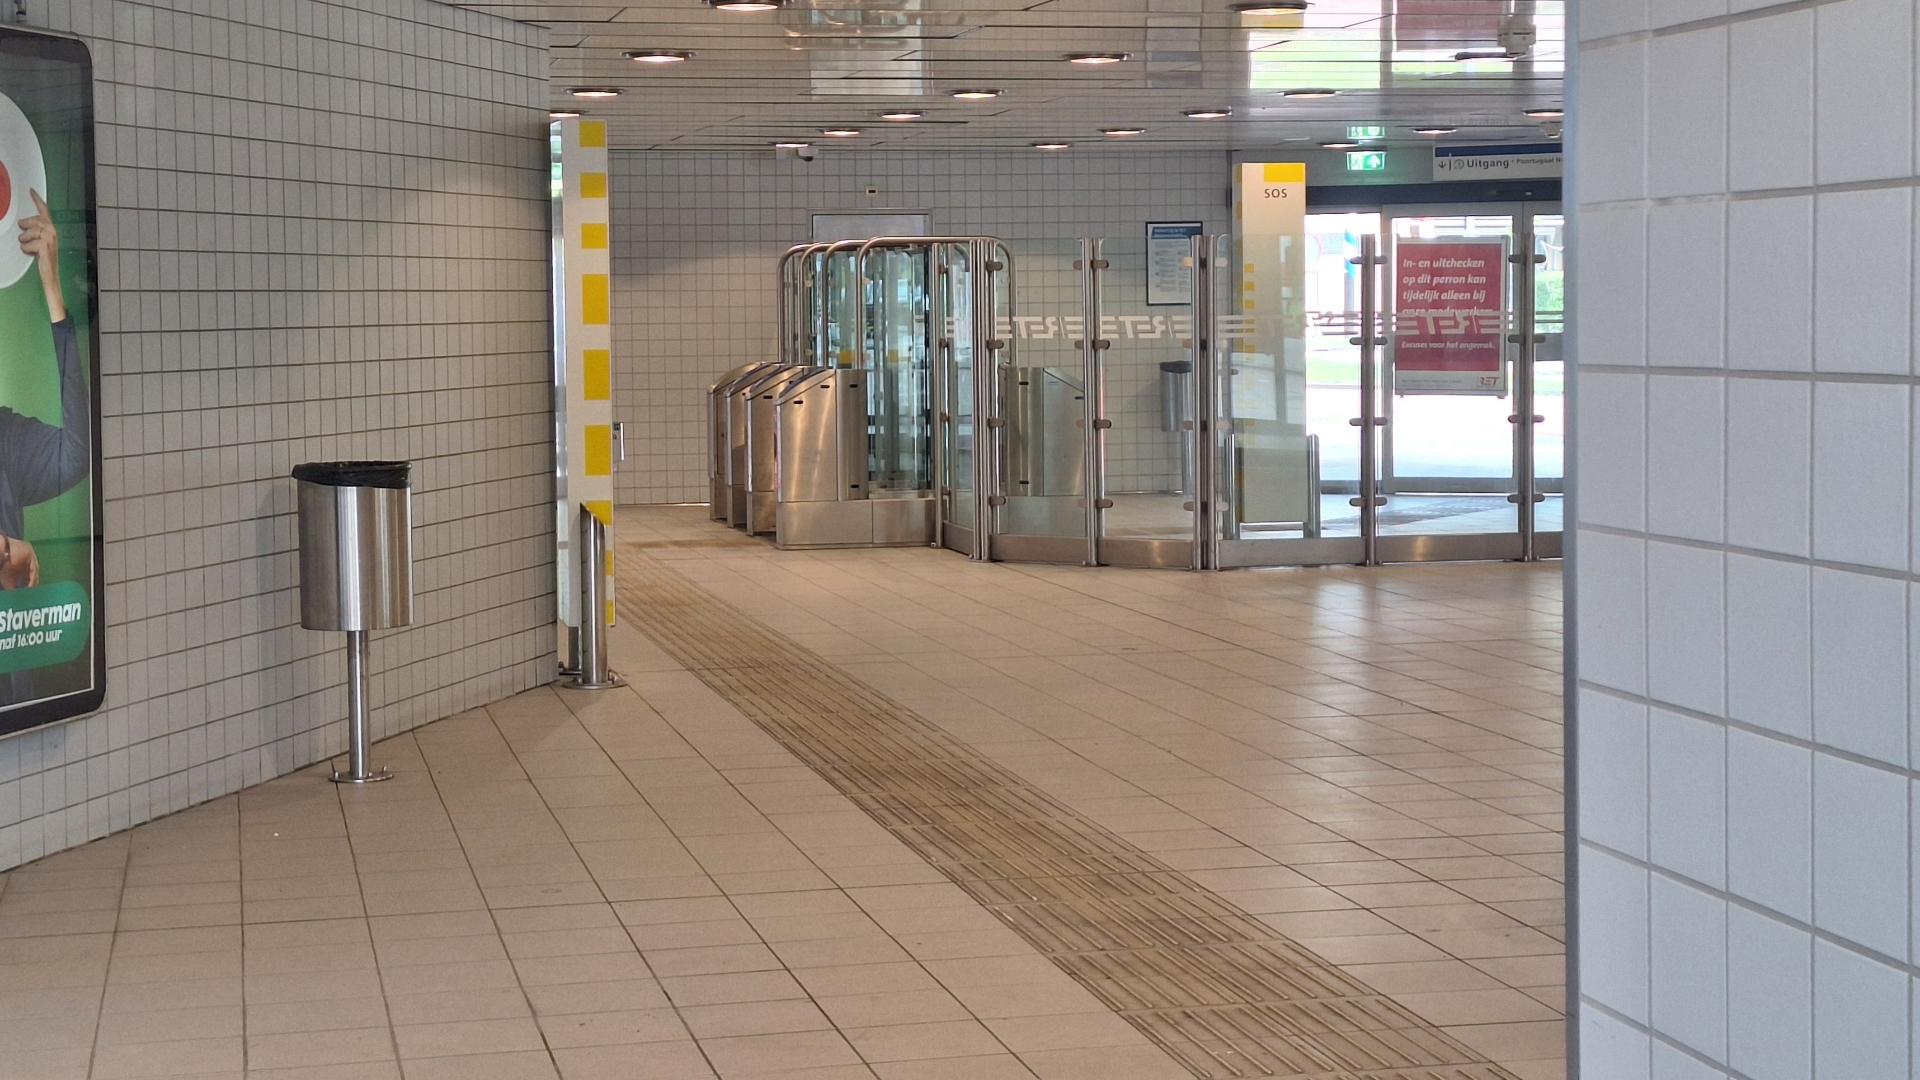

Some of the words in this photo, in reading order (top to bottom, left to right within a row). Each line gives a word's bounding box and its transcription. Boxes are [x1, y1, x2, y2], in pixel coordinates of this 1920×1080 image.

[1467, 159, 1509, 169] Uitgang
[1516, 156, 1554, 165] Poortugaal
[1264, 188, 1288, 199] SOS
[1403, 258, 1417, 268] In-
[1418, 260, 1430, 268] en
[1433, 257, 1485, 268] uitchecken
[1402, 276, 1415, 287] op
[1417, 273, 1431, 284] dit
[1432, 276, 1466, 287] perron
[1467, 273, 1486, 284] kan
[1403, 289, 1440, 303] tijdelijk
[1441, 289, 1471, 300] alleen
[1473, 289, 1486, 303] bij
[1401, 340, 1428, 349] Excuses
[1446, 341, 1458, 349] het
[0, 602, 81, 633] Staverman
[17, 630, 43, 647] 16:00
[45, 629, 63, 643] uur
